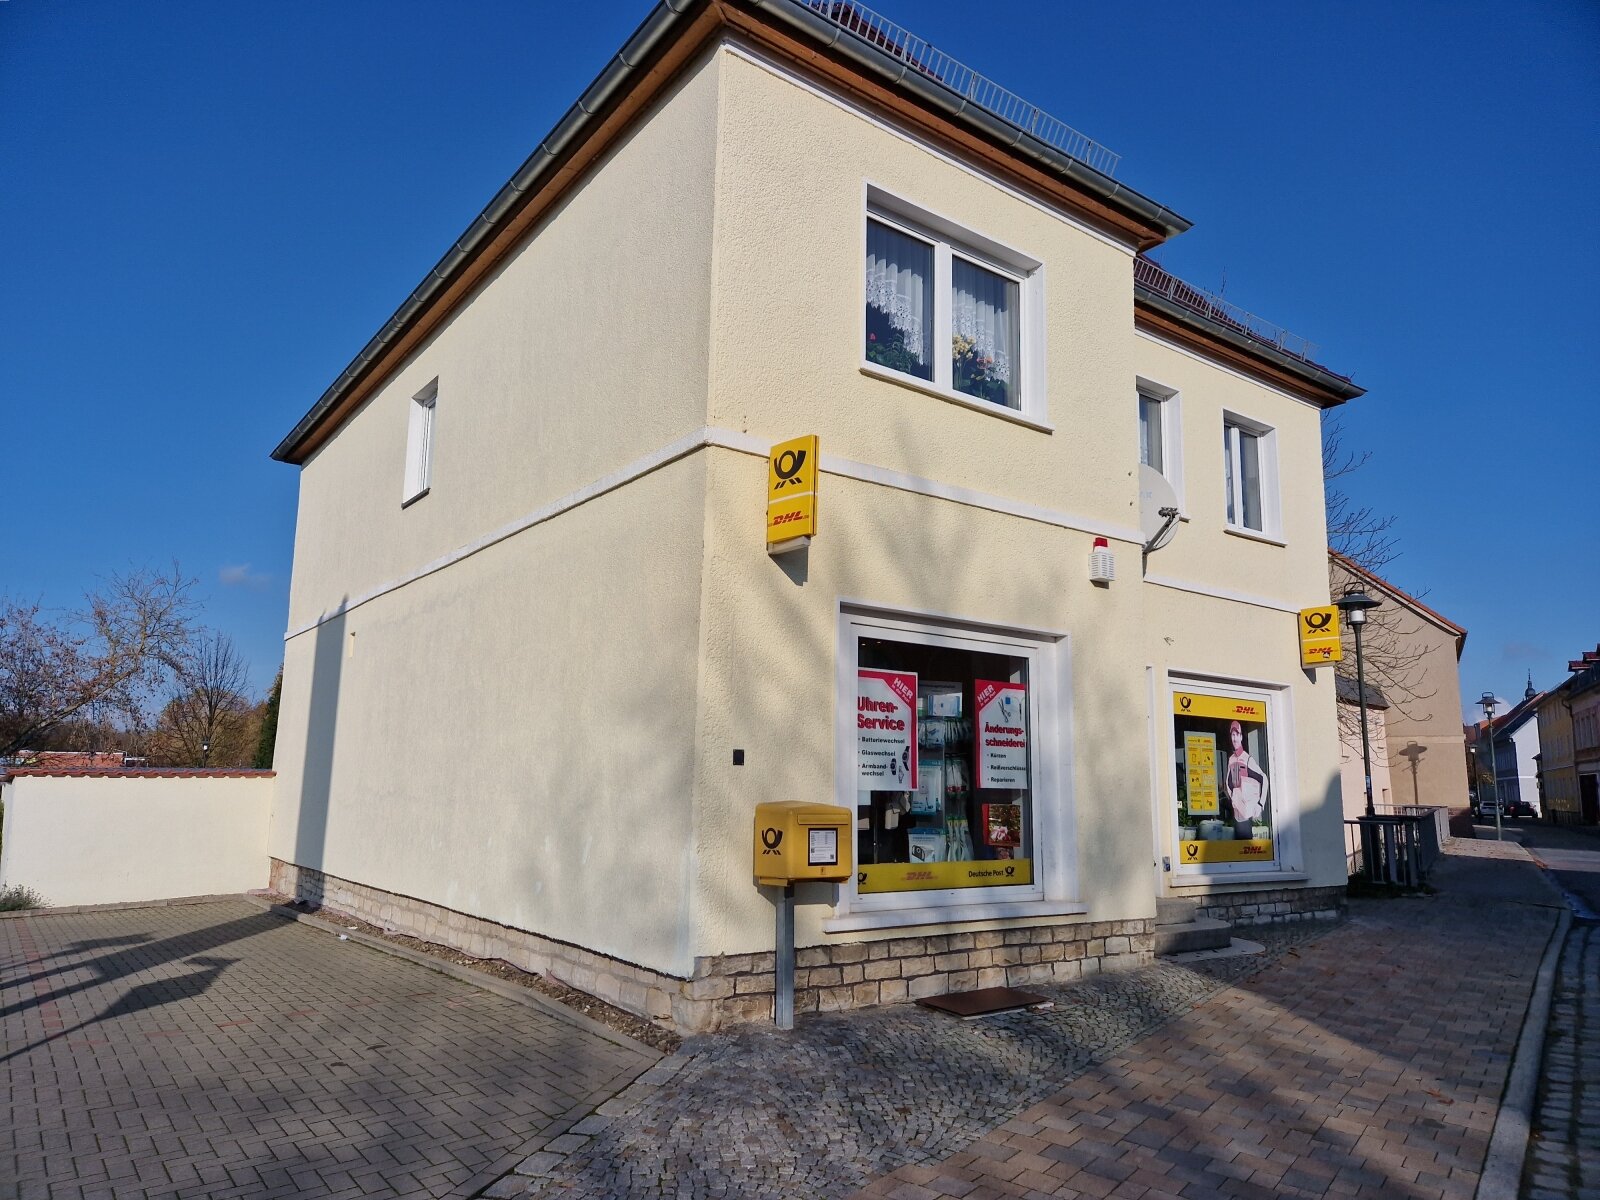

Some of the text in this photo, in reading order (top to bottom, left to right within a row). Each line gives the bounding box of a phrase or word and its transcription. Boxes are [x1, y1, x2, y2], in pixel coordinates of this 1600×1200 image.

[773, 511, 803, 526] DHL
[1309, 647, 1333, 655] DHL
[893, 677, 914, 700] HIER
[976, 684, 995, 703] HIER
[858, 695, 899, 713] Uhren-
[1235, 705, 1256, 715] DHL
[858, 713, 906, 731] Service
[985, 722, 1024, 737] Änderungs-
[861, 736, 906, 745] Batteriewechsel
[985, 737, 1026, 748] schneiderei
[861, 749, 896, 757] Glaswechsel
[1242, 846, 1263, 855] DHL
[906, 871, 934, 880] DHL
[968, 869, 1004, 878] Deutsche Post
